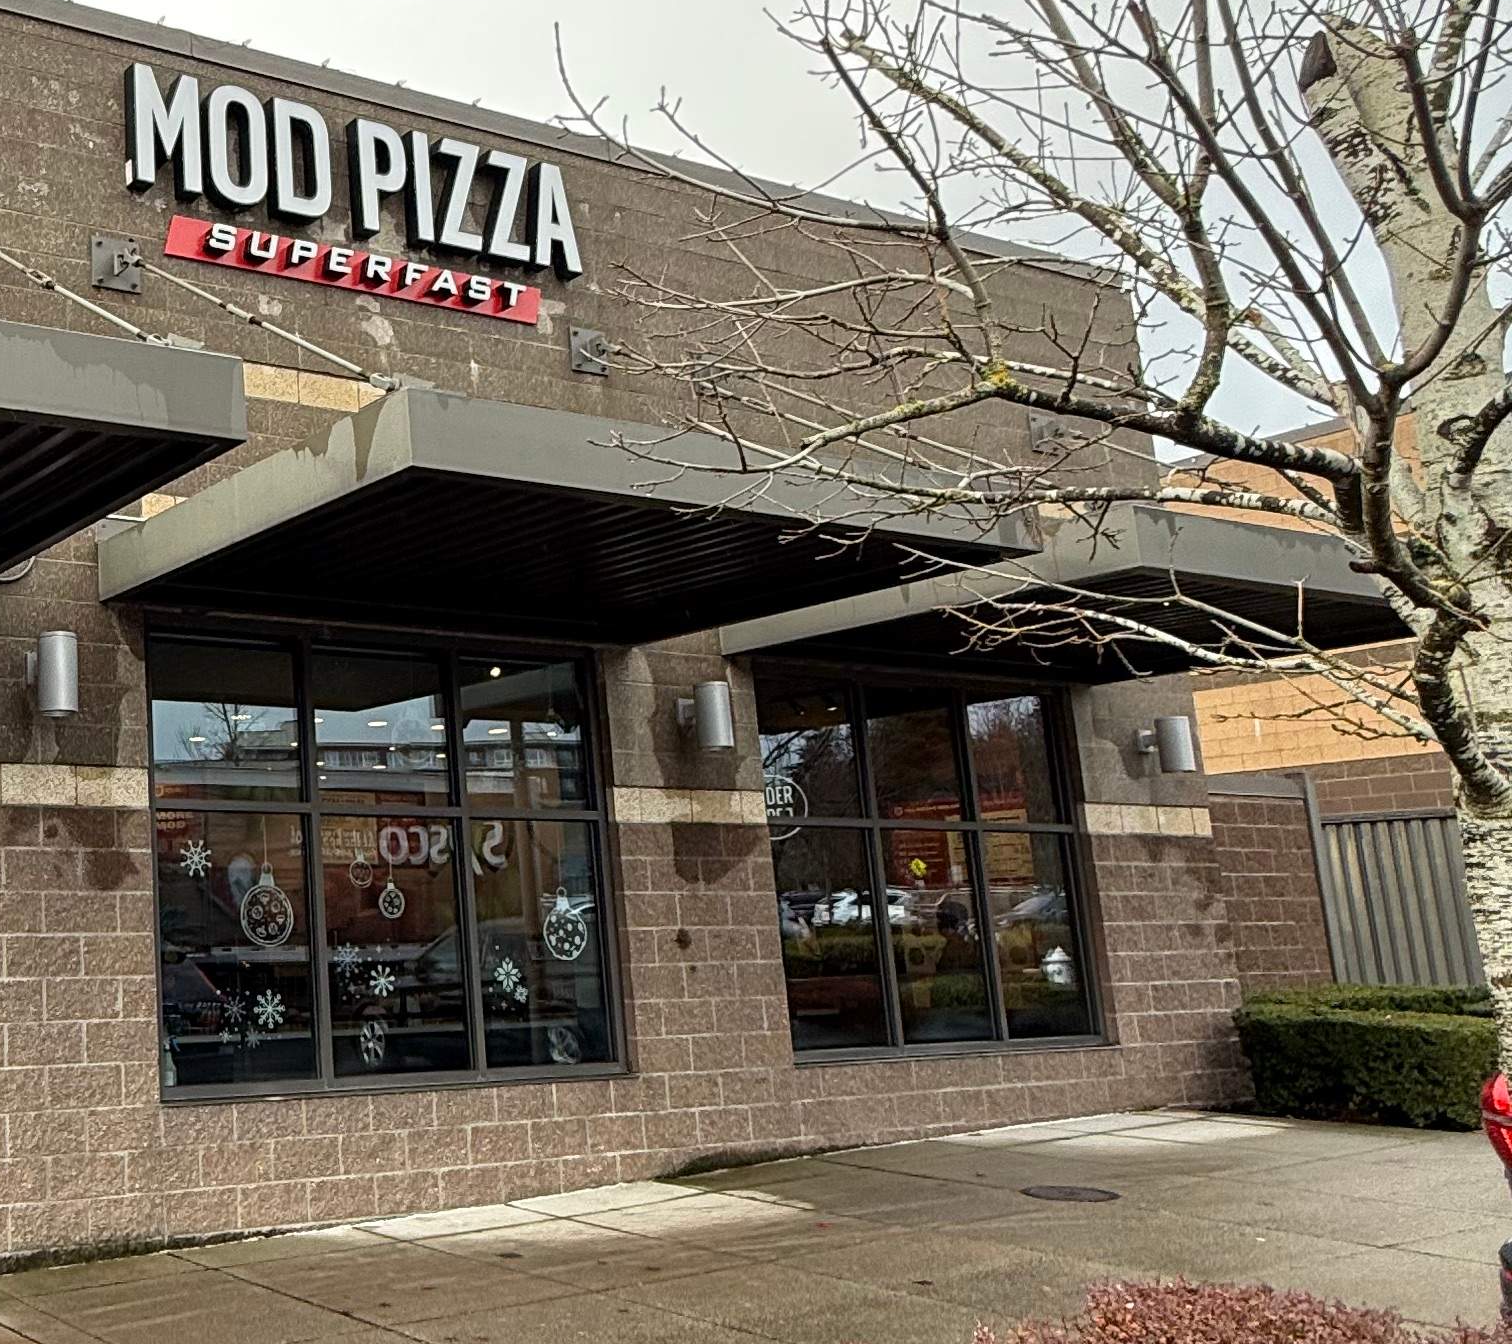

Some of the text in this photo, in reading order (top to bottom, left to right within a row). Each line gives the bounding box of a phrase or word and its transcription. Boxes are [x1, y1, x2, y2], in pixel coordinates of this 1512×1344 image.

[127, 63, 583, 277] MOD PIZZA
[207, 223, 526, 307] SUPERFAST
